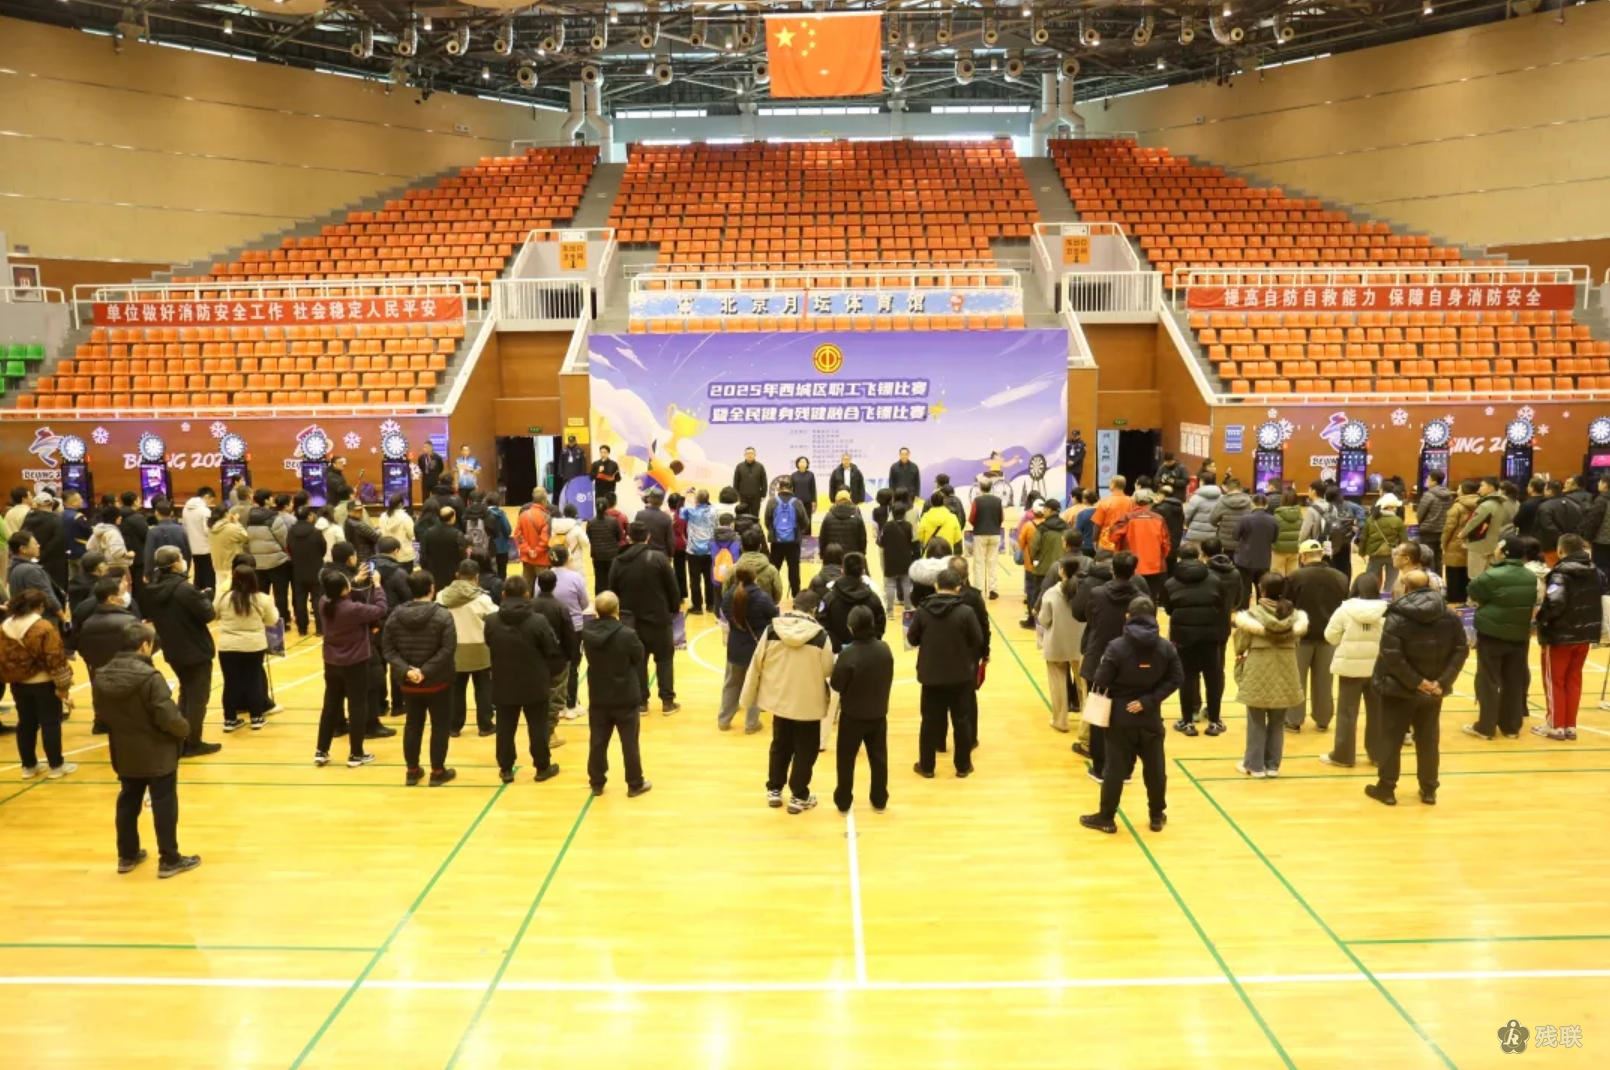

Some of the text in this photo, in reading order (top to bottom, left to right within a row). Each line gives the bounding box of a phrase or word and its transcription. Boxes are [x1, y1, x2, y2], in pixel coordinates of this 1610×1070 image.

[720, 296, 926, 314] 北京月坛体育馆
[1224, 288, 1541, 307] 提高自防自救能力 保障自身消防安全
[106, 300, 437, 322] 单位做好消防安全工作 社会稳定人民平安
[710, 381, 928, 398] 2025年西城区职工飞镖比赛
